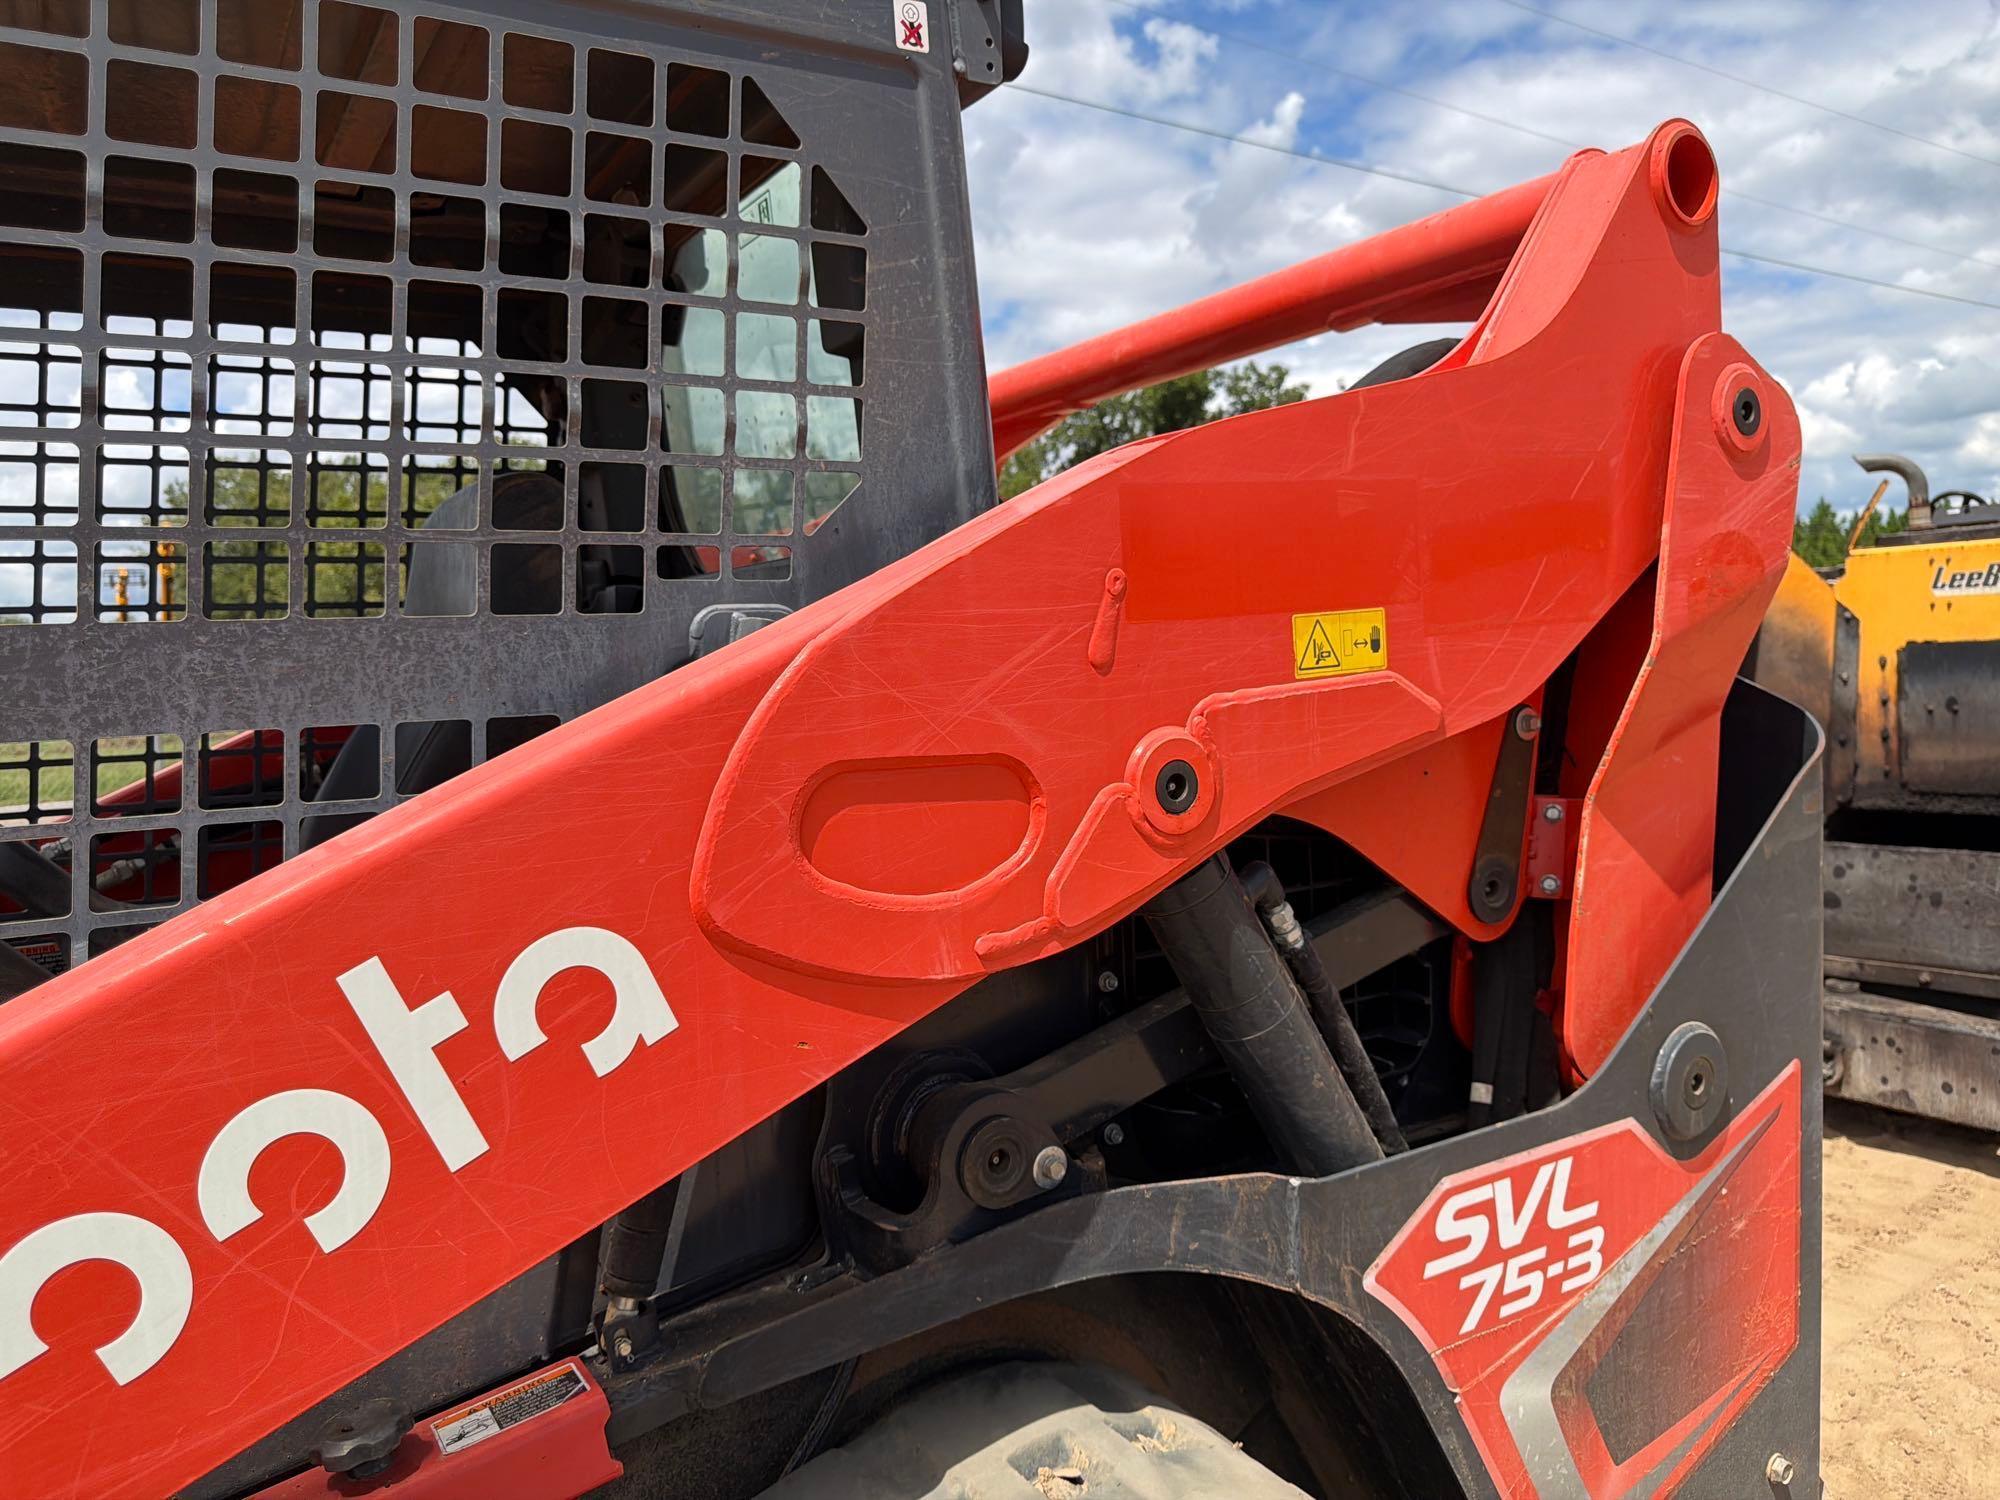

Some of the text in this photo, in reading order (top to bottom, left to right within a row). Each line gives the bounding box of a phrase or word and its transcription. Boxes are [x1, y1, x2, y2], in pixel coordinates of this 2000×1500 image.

[1931, 563, 2000, 590] LeeB
[1422, 1156, 1599, 1280] SVL
[1458, 1225, 1605, 1335] 75-3
[481, 1377, 546, 1408] WARNING
